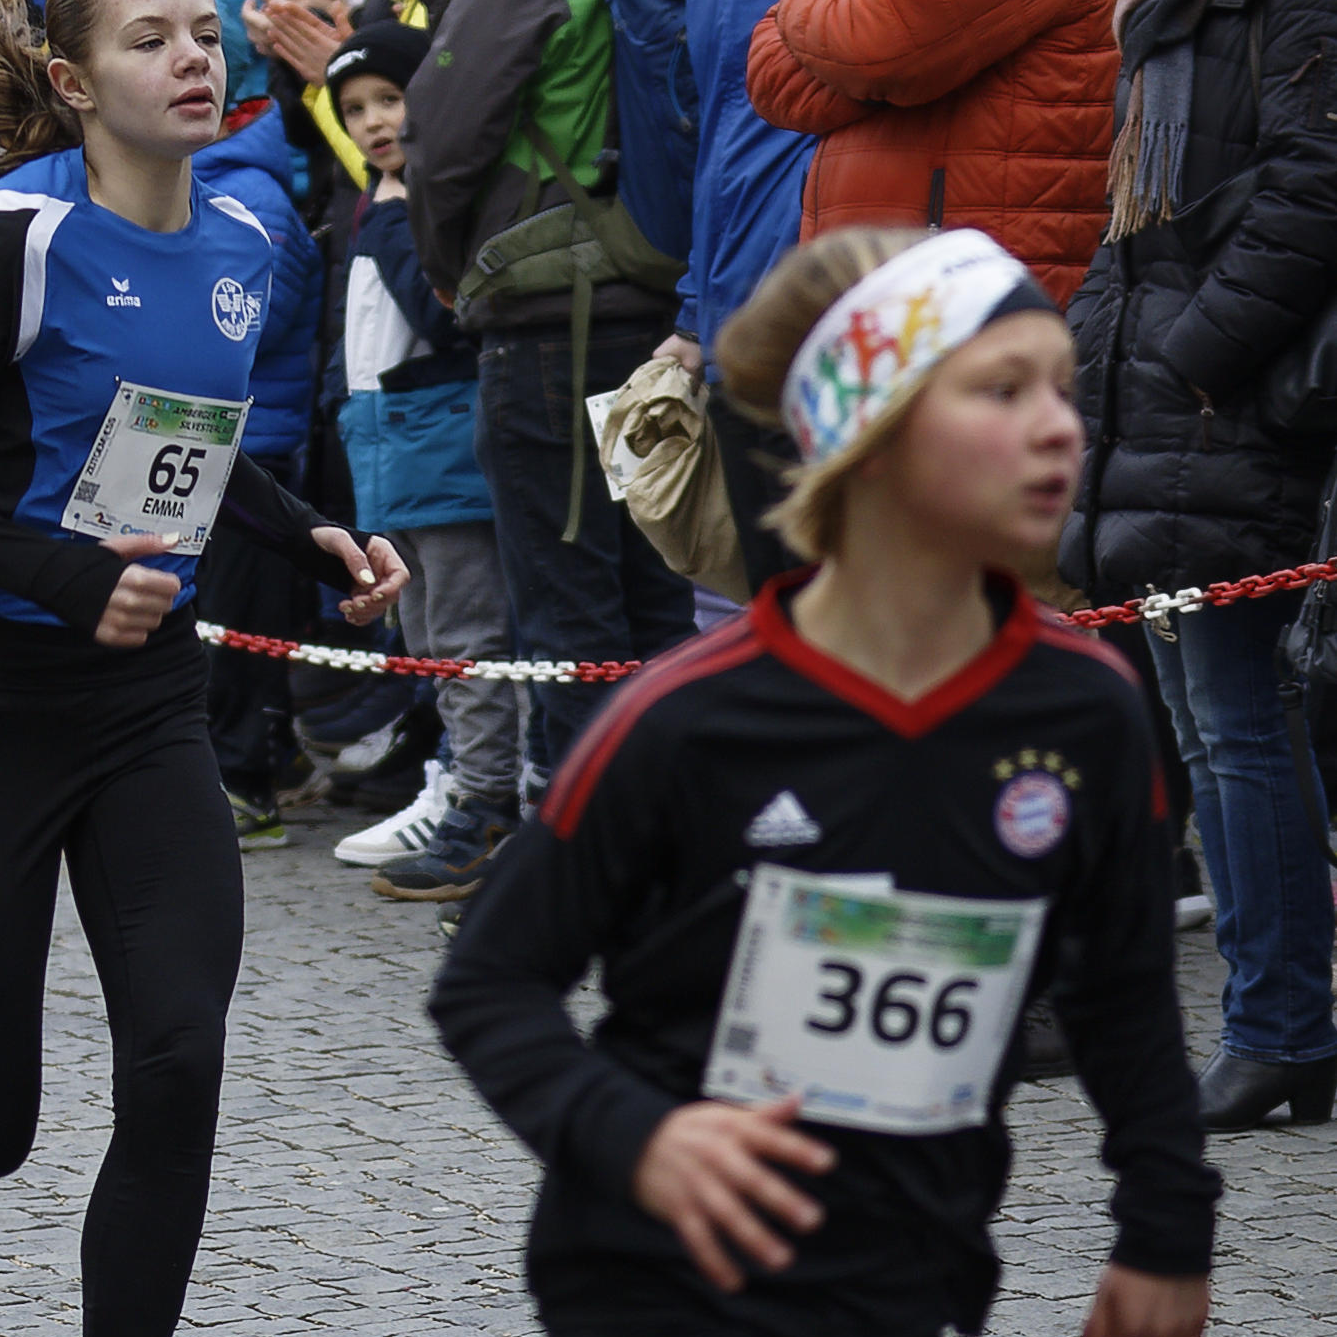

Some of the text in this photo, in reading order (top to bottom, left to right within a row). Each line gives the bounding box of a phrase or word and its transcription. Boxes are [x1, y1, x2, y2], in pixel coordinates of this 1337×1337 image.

[106, 293, 142, 308] erima
[148, 444, 207, 498] 65
[142, 497, 186, 519] EMMA
[806, 961, 979, 1049] 366
